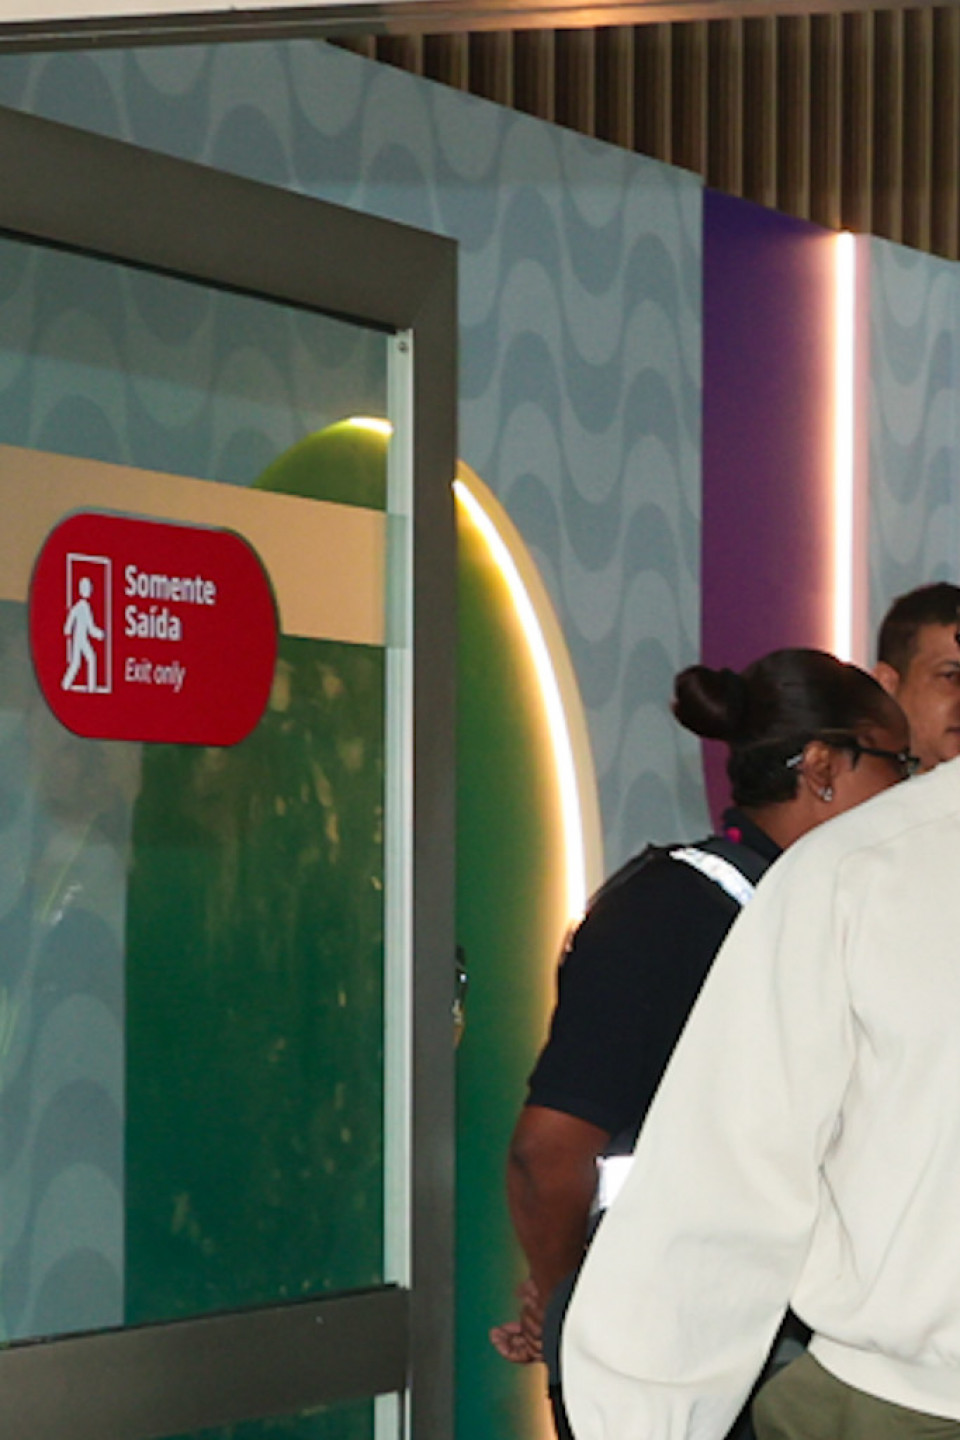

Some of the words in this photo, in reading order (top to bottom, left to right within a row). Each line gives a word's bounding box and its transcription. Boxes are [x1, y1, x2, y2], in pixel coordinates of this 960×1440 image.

[124, 565, 216, 605] Somente
[124, 605, 182, 641] Saída
[125, 657, 152, 683] Exit
[154, 662, 185, 693] only
